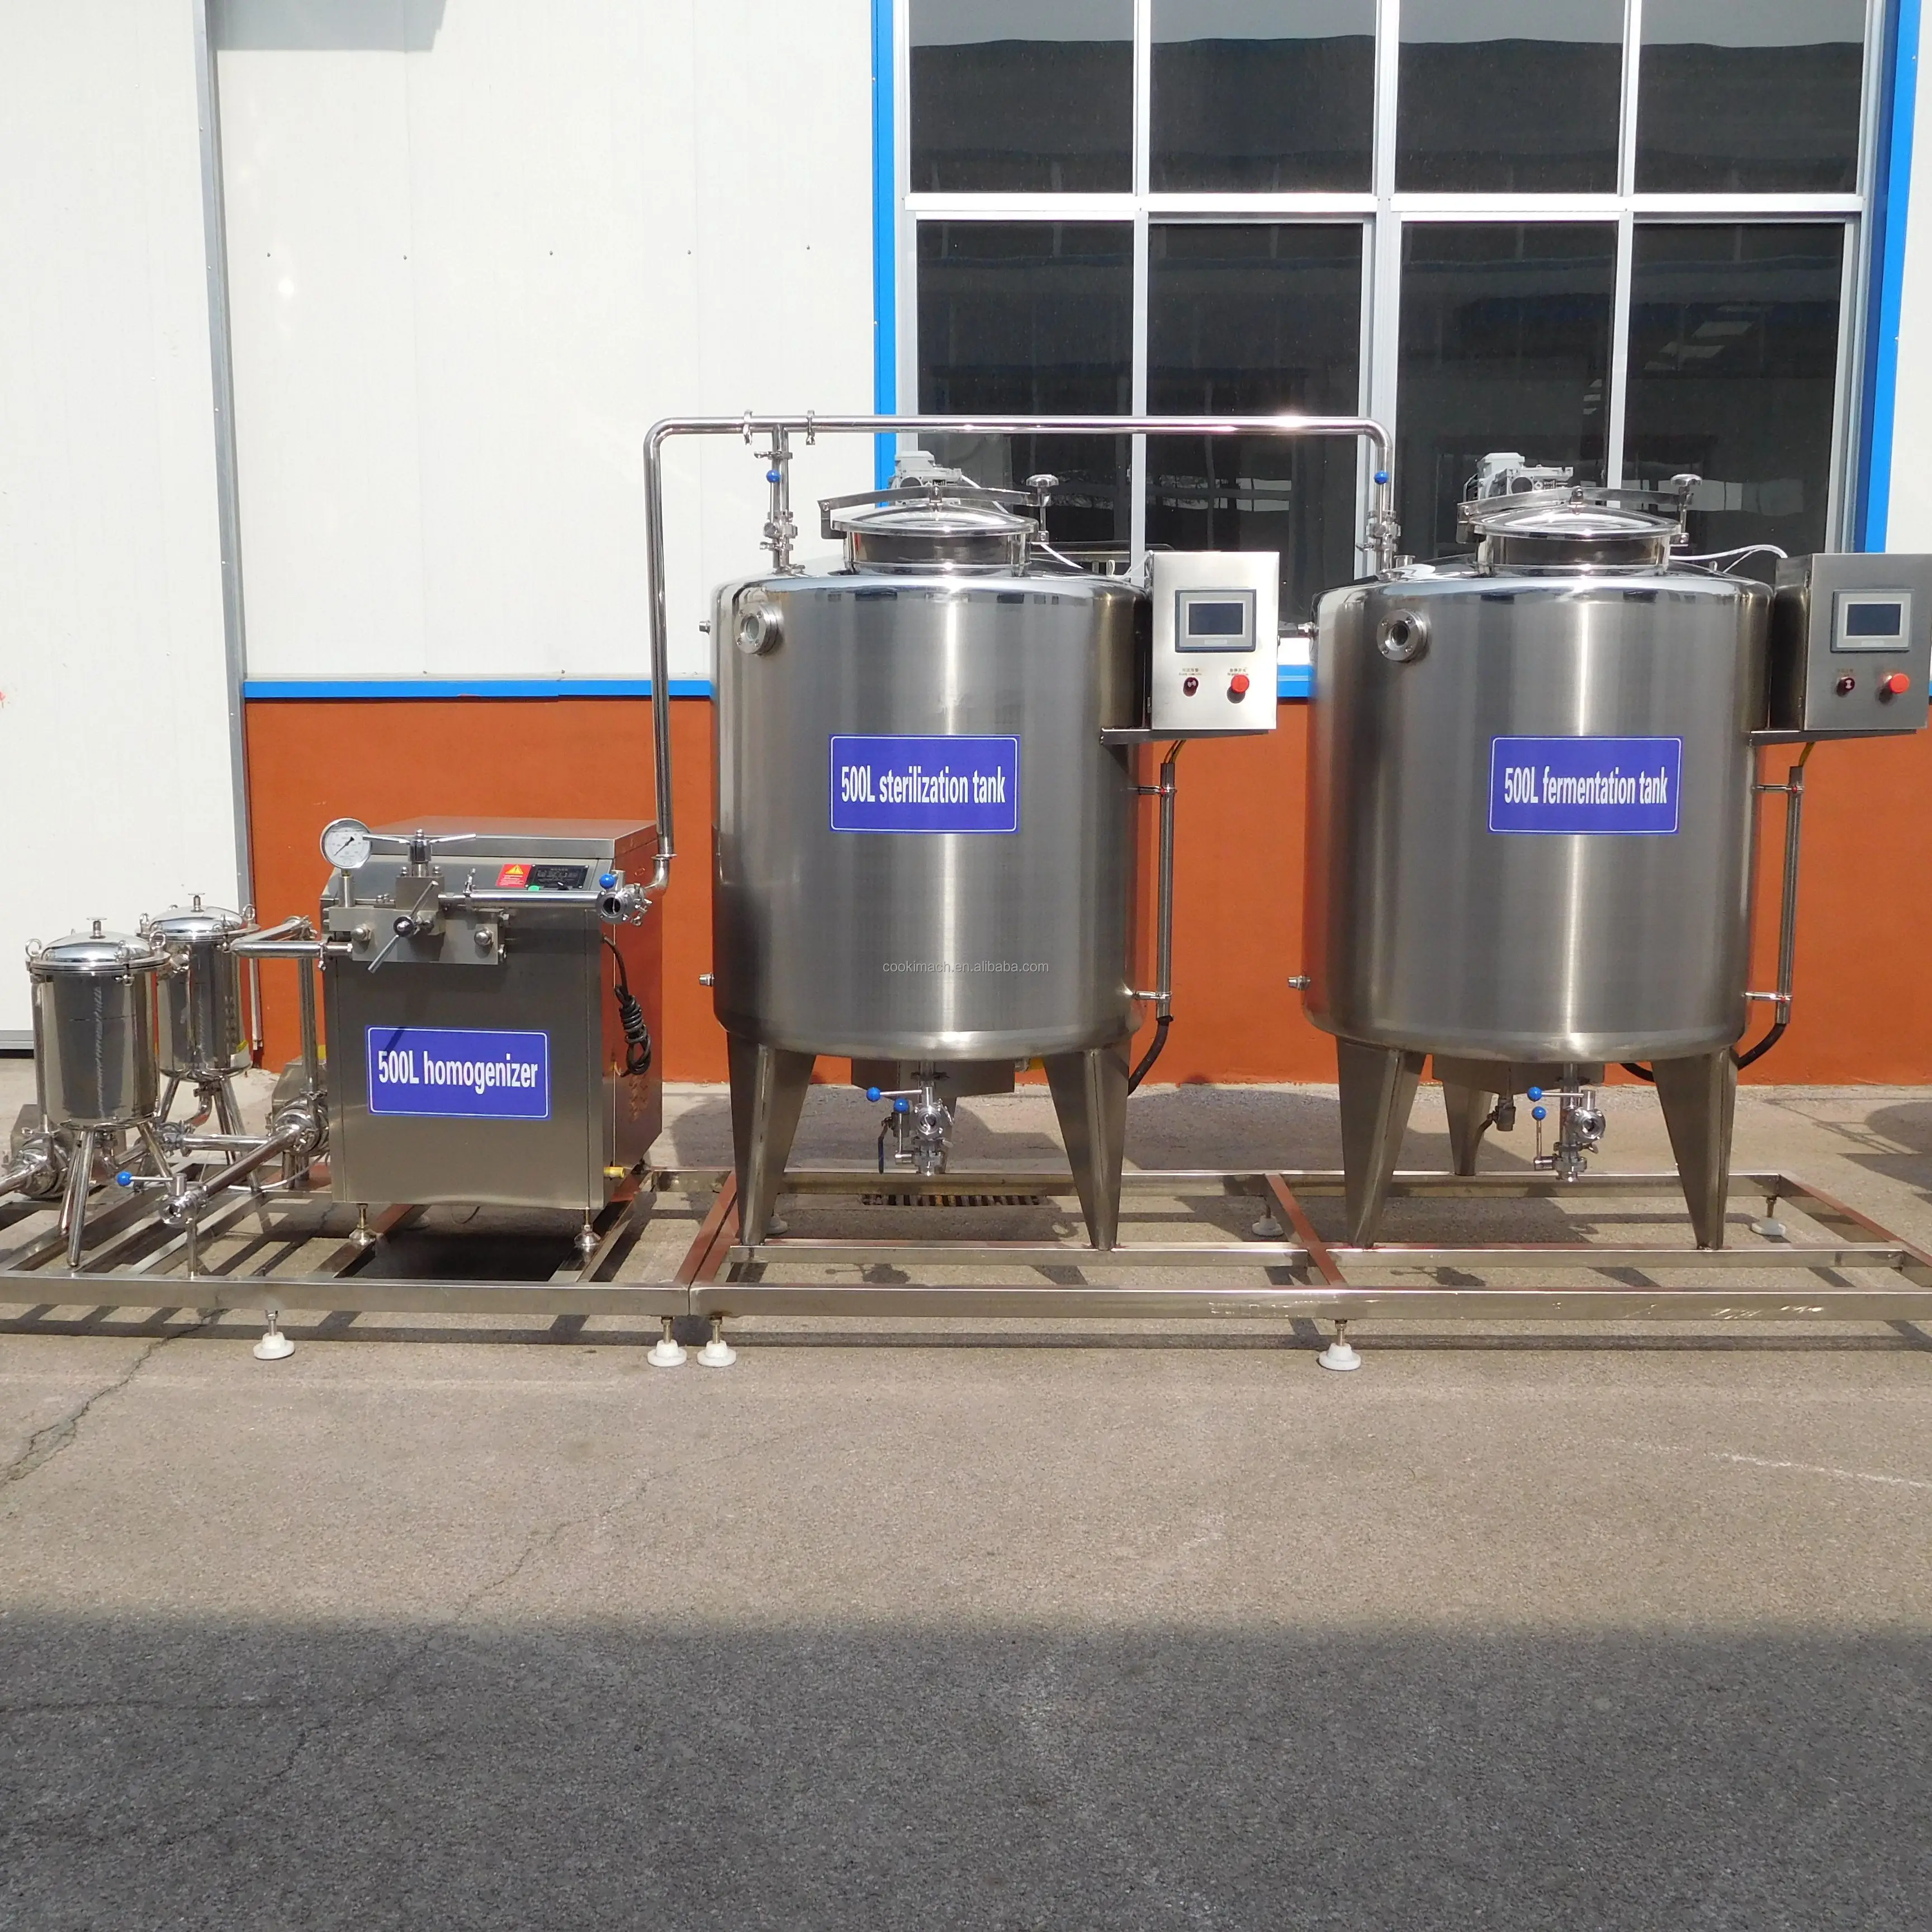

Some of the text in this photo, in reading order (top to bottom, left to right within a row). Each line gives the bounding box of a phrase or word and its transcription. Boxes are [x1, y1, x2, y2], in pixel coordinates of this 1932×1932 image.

[841, 765, 1006, 803] 500L sterilization tank
[1504, 766, 1668, 804] 500L fermentation tank
[378, 1050, 538, 1095] 500L homogenizer
